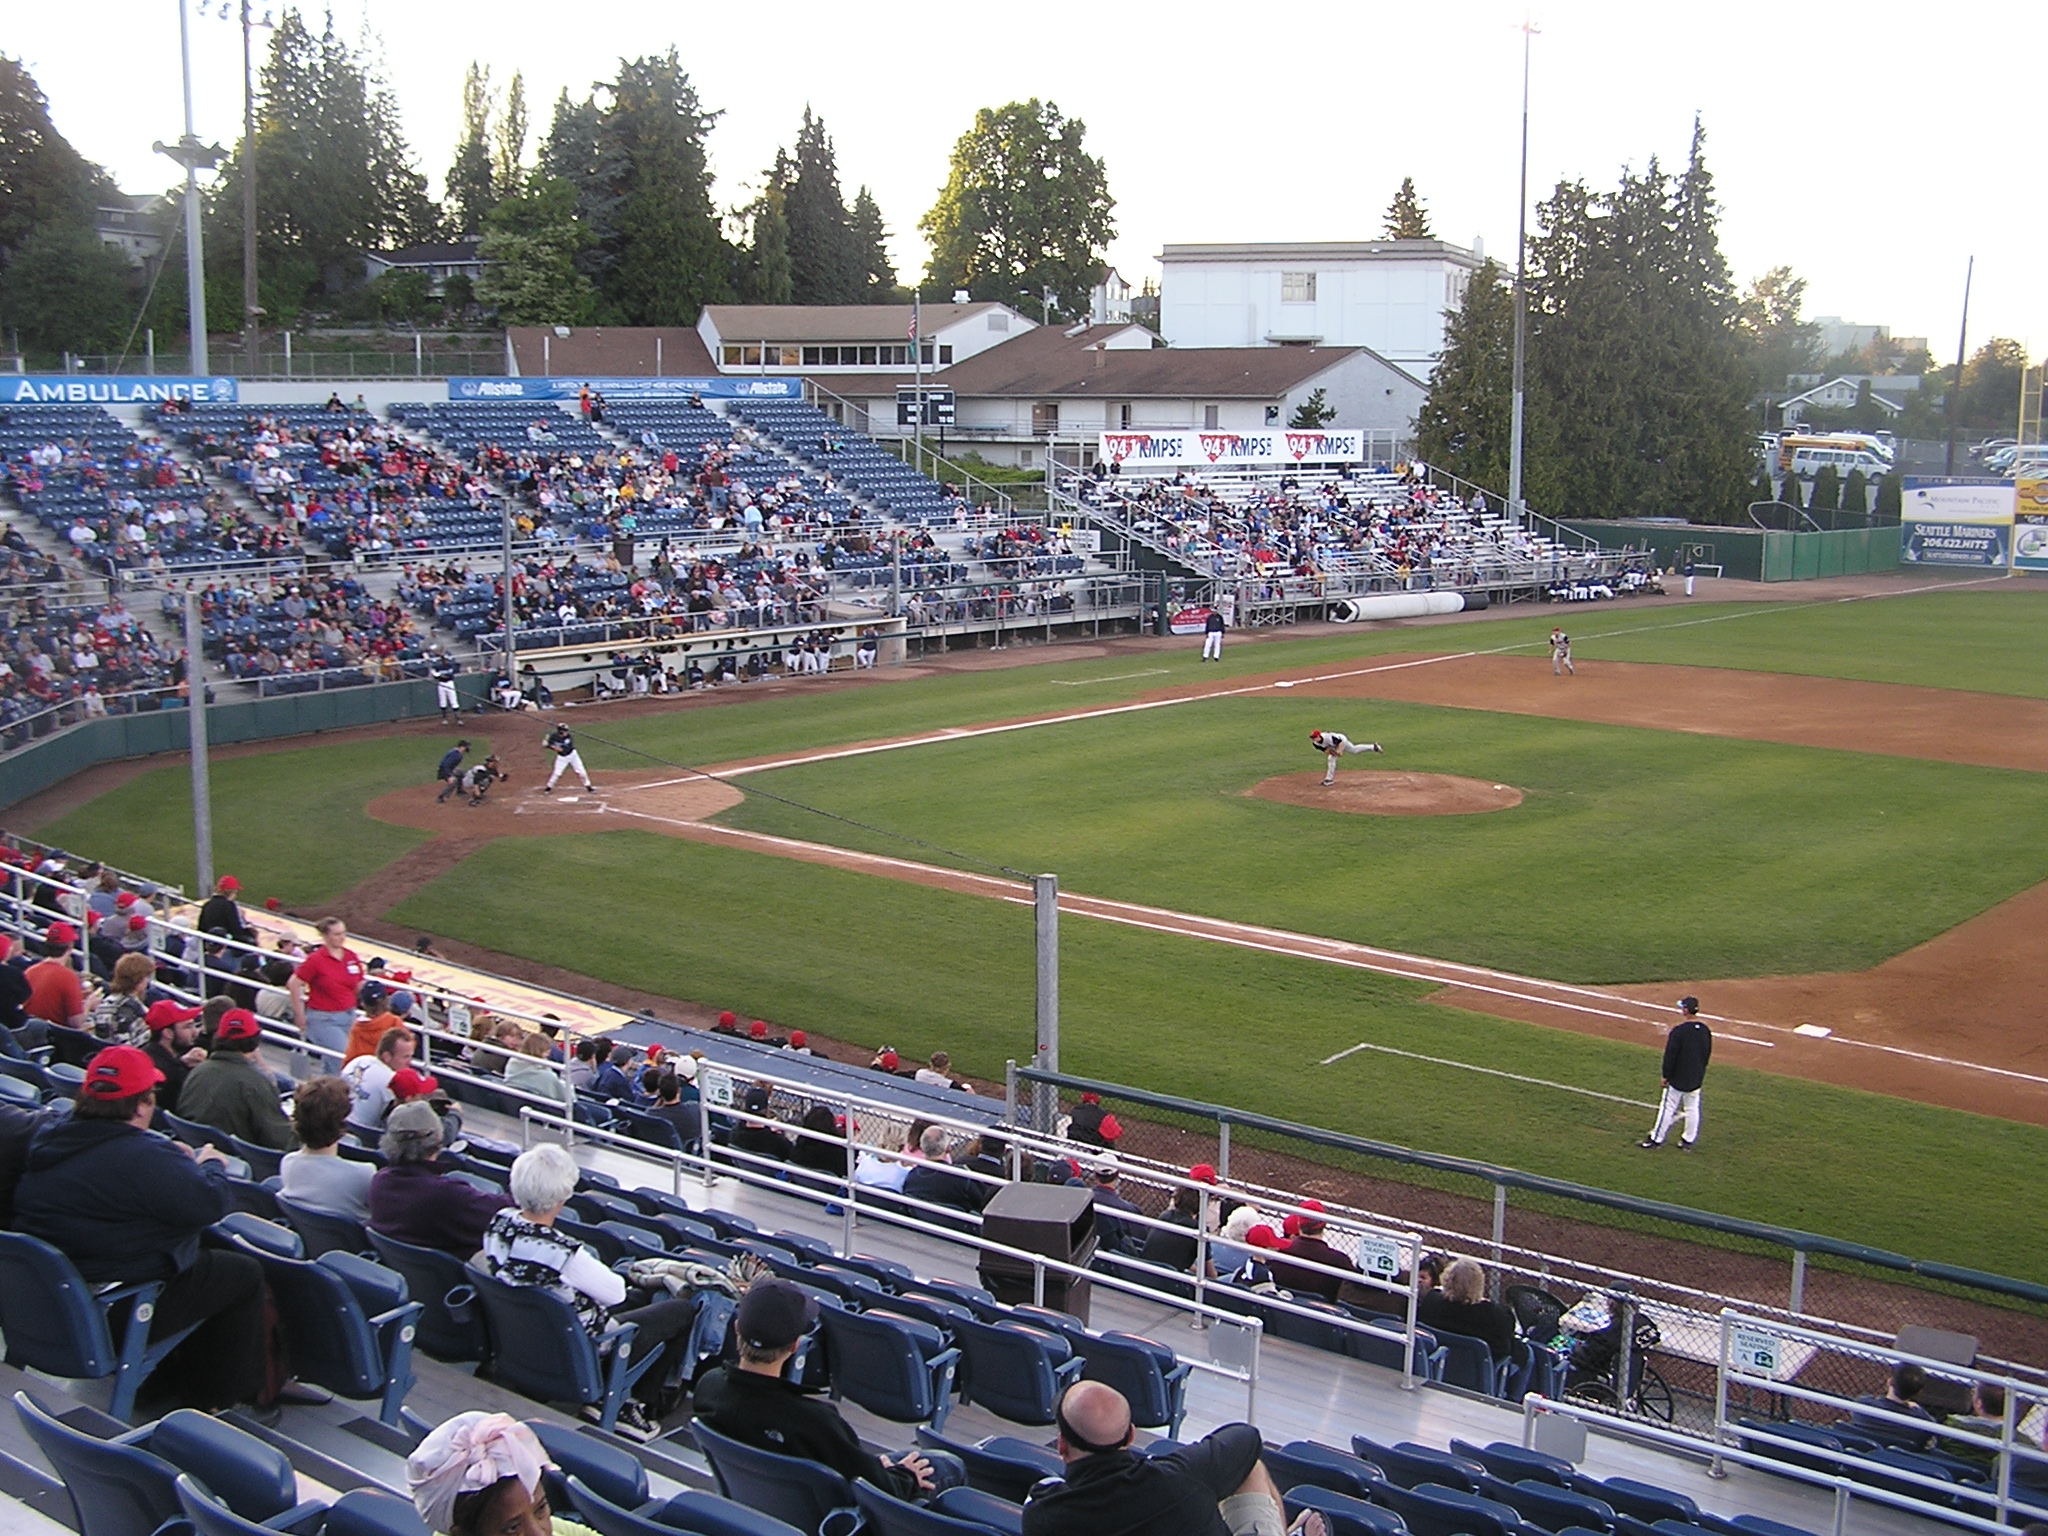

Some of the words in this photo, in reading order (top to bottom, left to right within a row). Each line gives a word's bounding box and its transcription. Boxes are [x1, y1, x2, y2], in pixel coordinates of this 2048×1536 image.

[15, 380, 209, 402] AMBULANCE
[477, 382, 523, 396] Allstate
[749, 382, 788, 395] Allstate
[1138, 438, 1177, 458] KMPS
[1230, 437, 1266, 456] KMPS
[1315, 437, 1349, 455] KMPS
[1737, 1333, 1776, 1347] RESERVED
